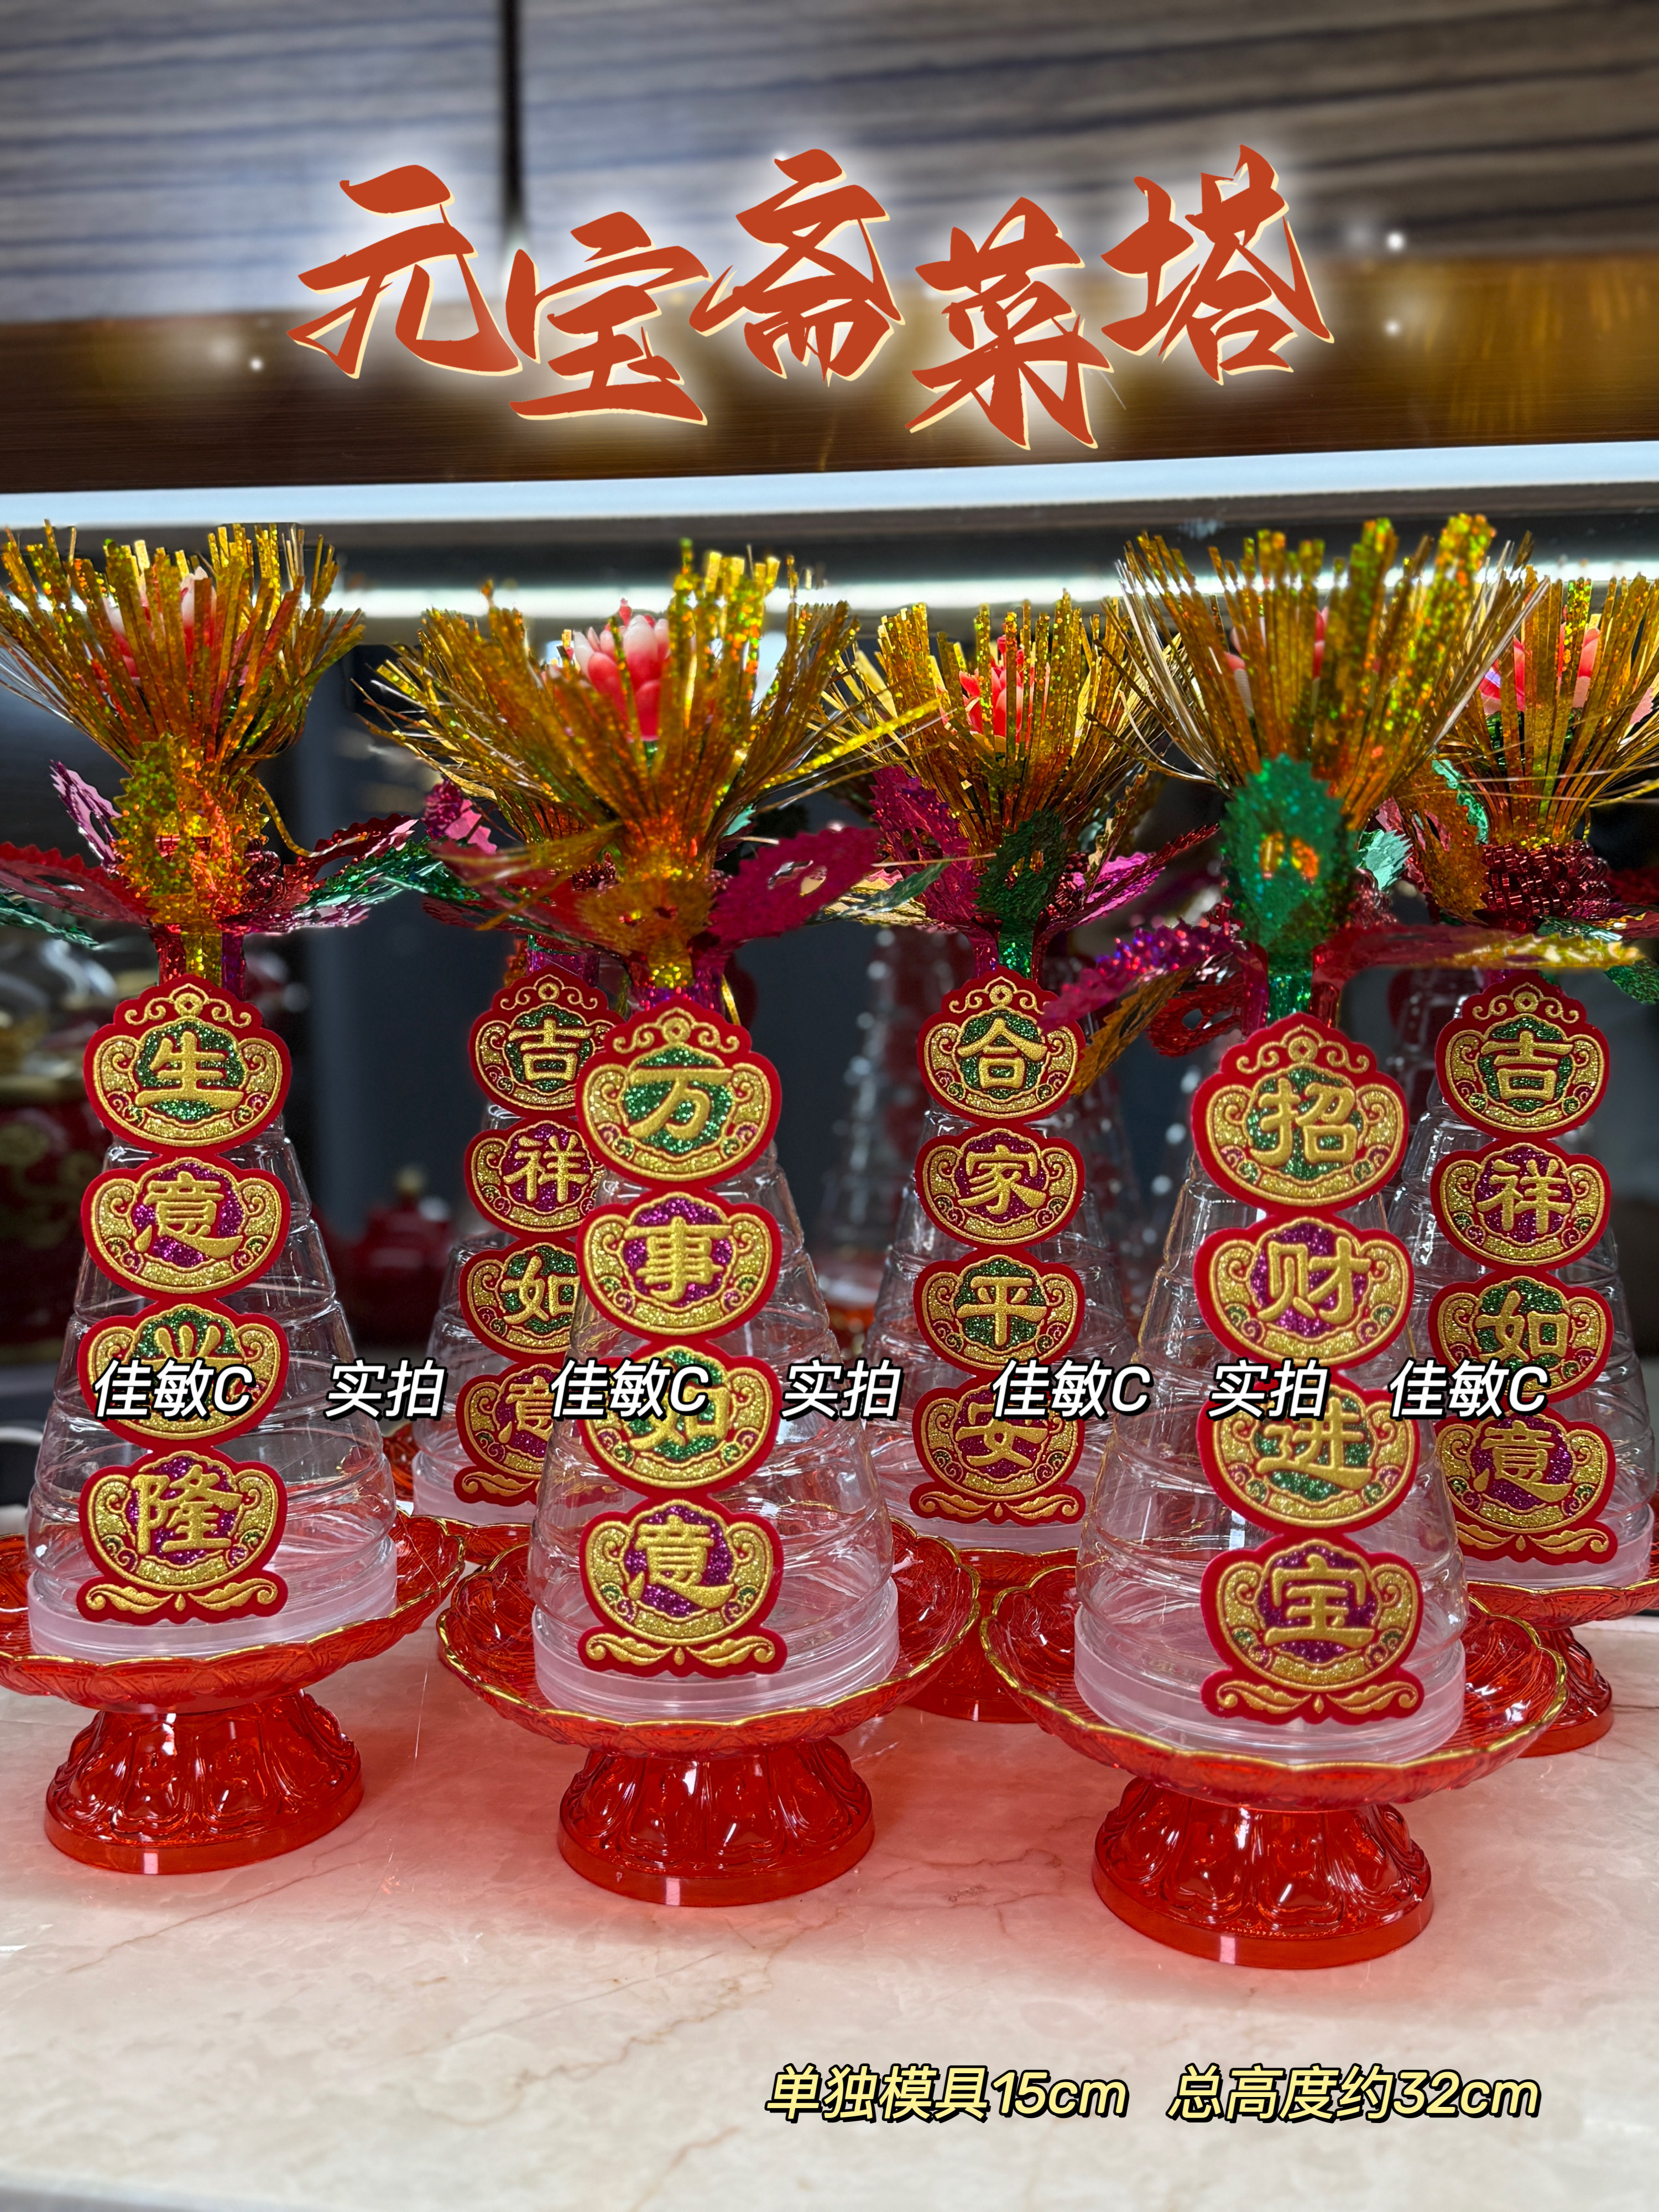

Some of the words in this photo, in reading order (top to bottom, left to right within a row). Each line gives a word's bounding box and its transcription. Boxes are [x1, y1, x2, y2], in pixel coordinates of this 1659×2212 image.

[1250, 1078, 1373, 1648] 招财进宝
[1474, 1031, 1573, 1503] 吉祥如意
